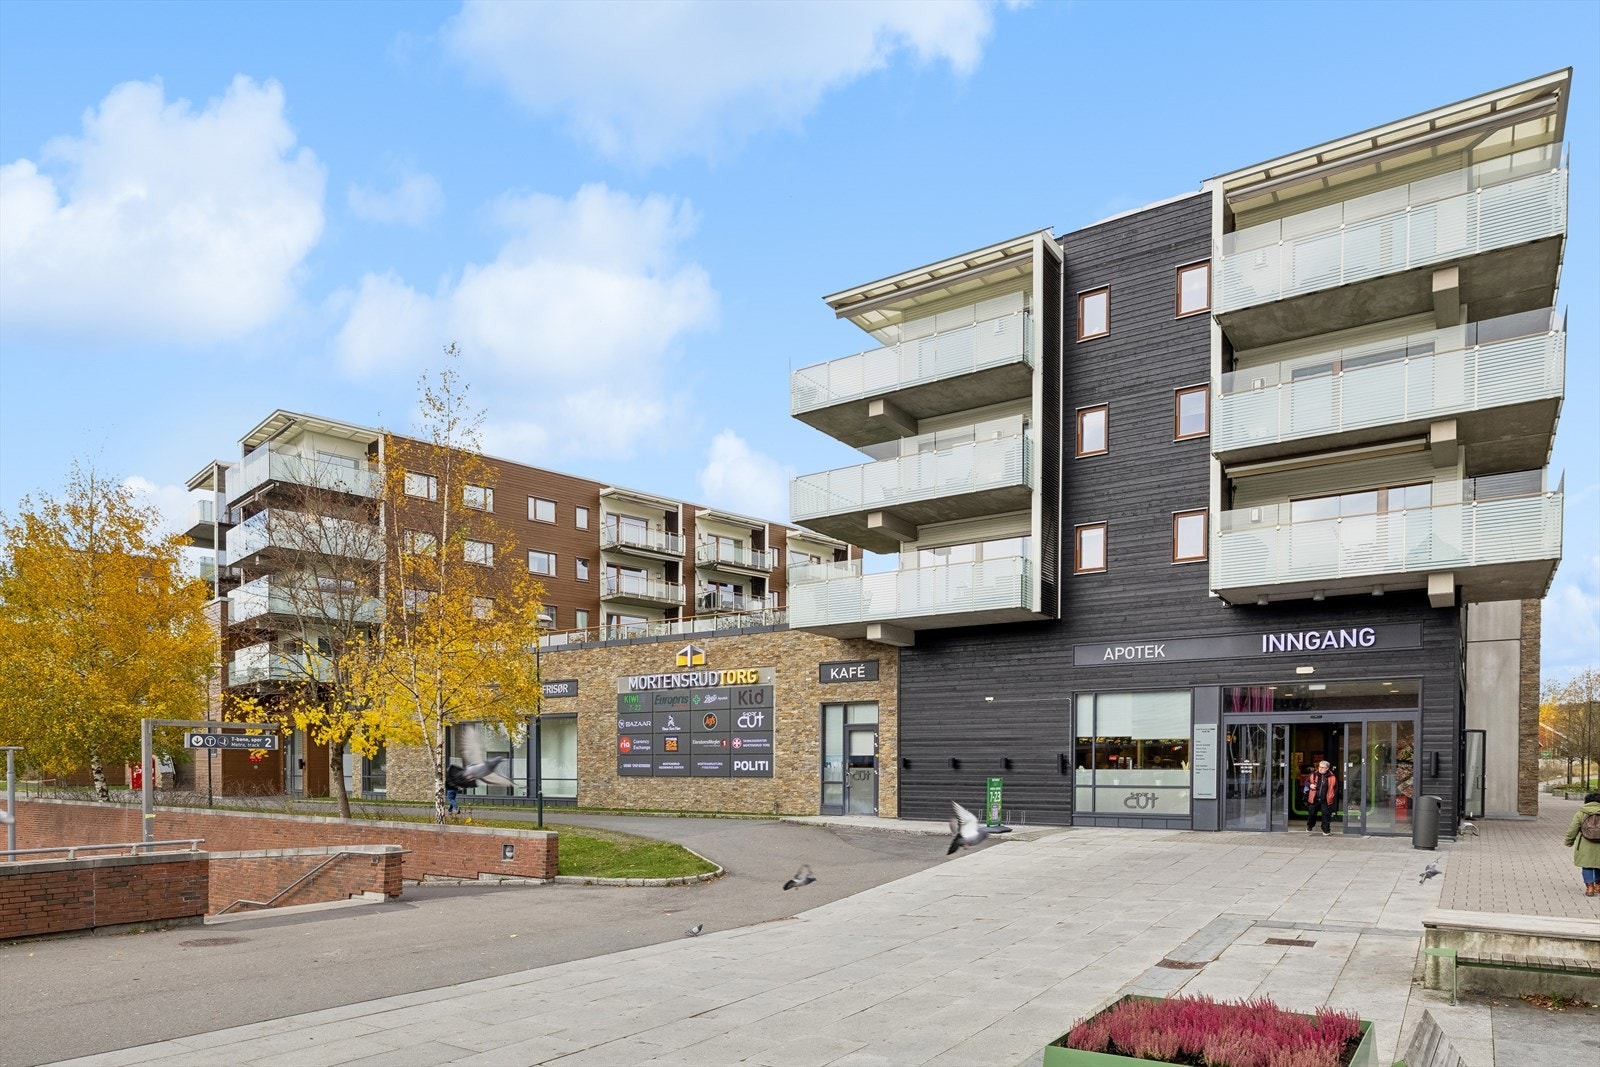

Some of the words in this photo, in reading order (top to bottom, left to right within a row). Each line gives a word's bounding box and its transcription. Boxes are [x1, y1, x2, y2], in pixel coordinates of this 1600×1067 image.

[1262, 627, 1376, 653] INNGANG
[1103, 644, 1166, 661] APOTEK
[830, 664, 866, 679] KAFÉ
[542, 684, 568, 694] FRISØR
[623, 694, 639, 704] KIWI
[654, 694, 689, 707] Europris
[738, 688, 764, 706] Kid
[625, 720, 652, 728] BAZAAR
[264, 737, 272, 748] 2
[620, 739, 631, 748] ria
[733, 760, 769, 771] POLITI
[990, 791, 1002, 802] 7-23
